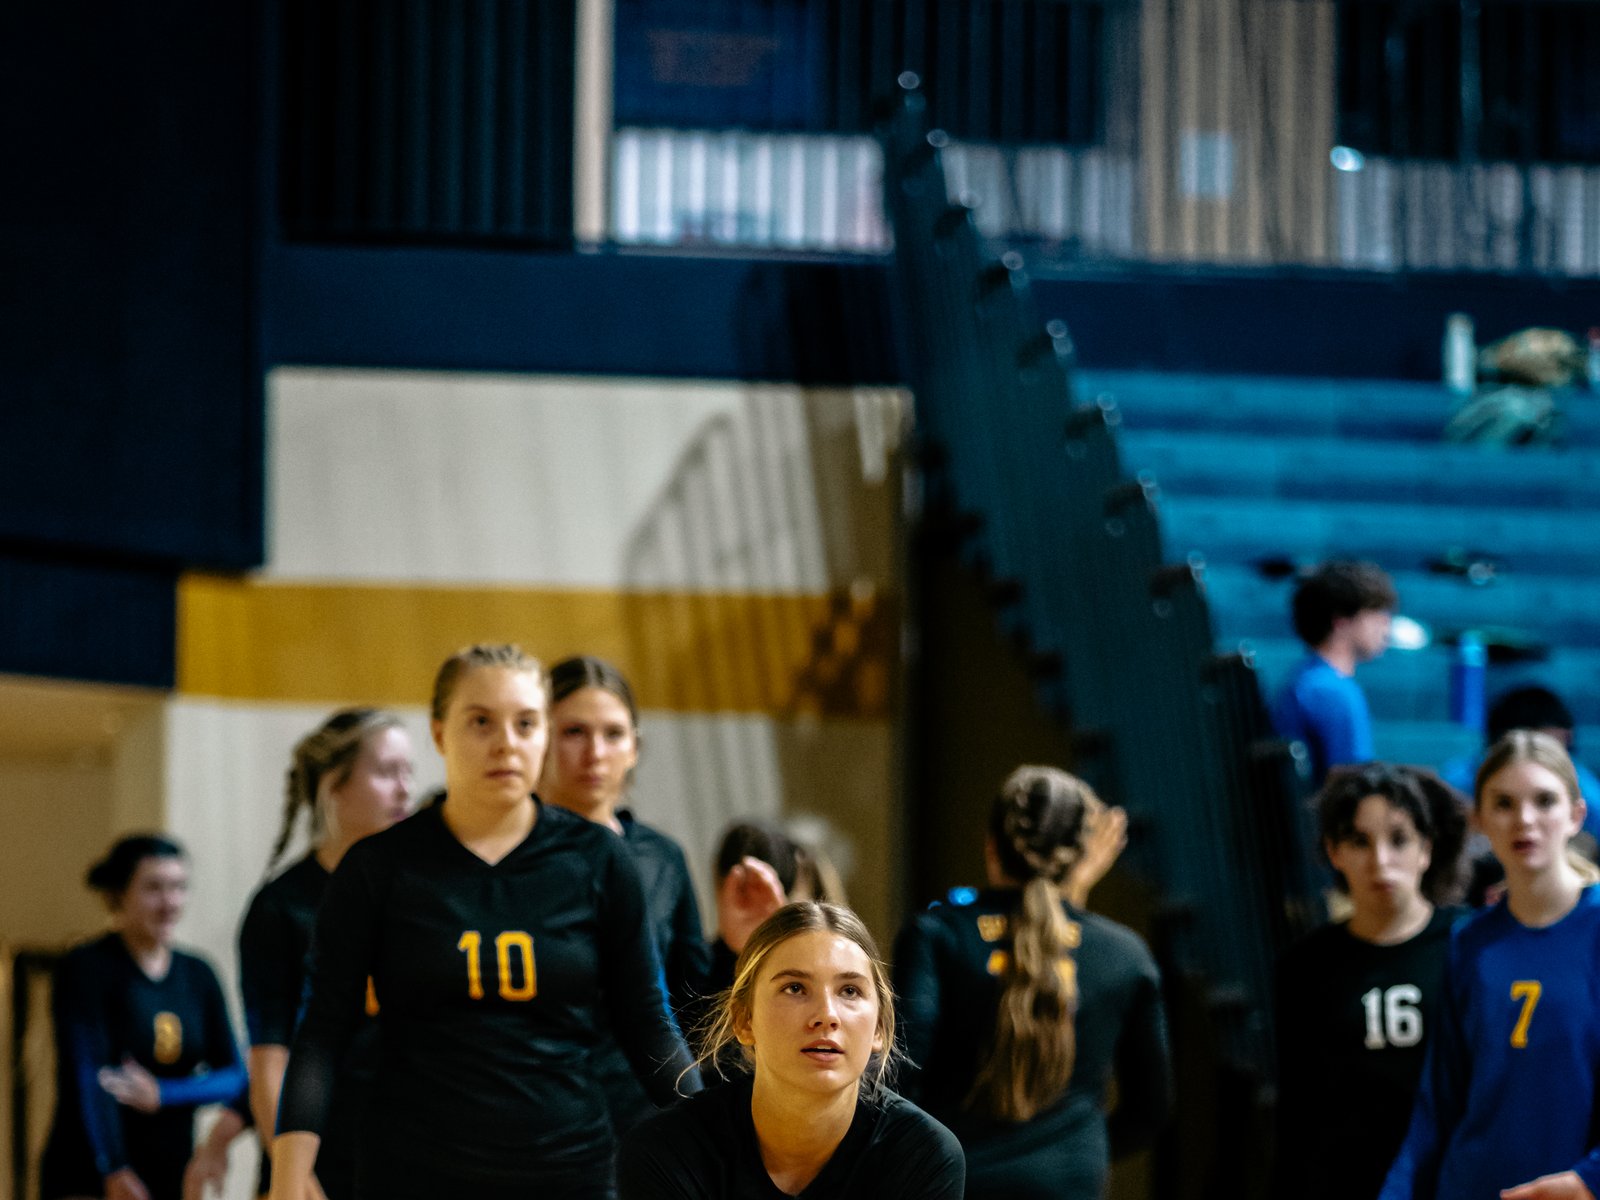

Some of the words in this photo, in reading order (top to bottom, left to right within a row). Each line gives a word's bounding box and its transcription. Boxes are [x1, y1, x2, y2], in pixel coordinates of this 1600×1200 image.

[457, 930, 538, 1001] 10
[1361, 983, 1423, 1049] 16
[1511, 980, 1542, 1048] 7
